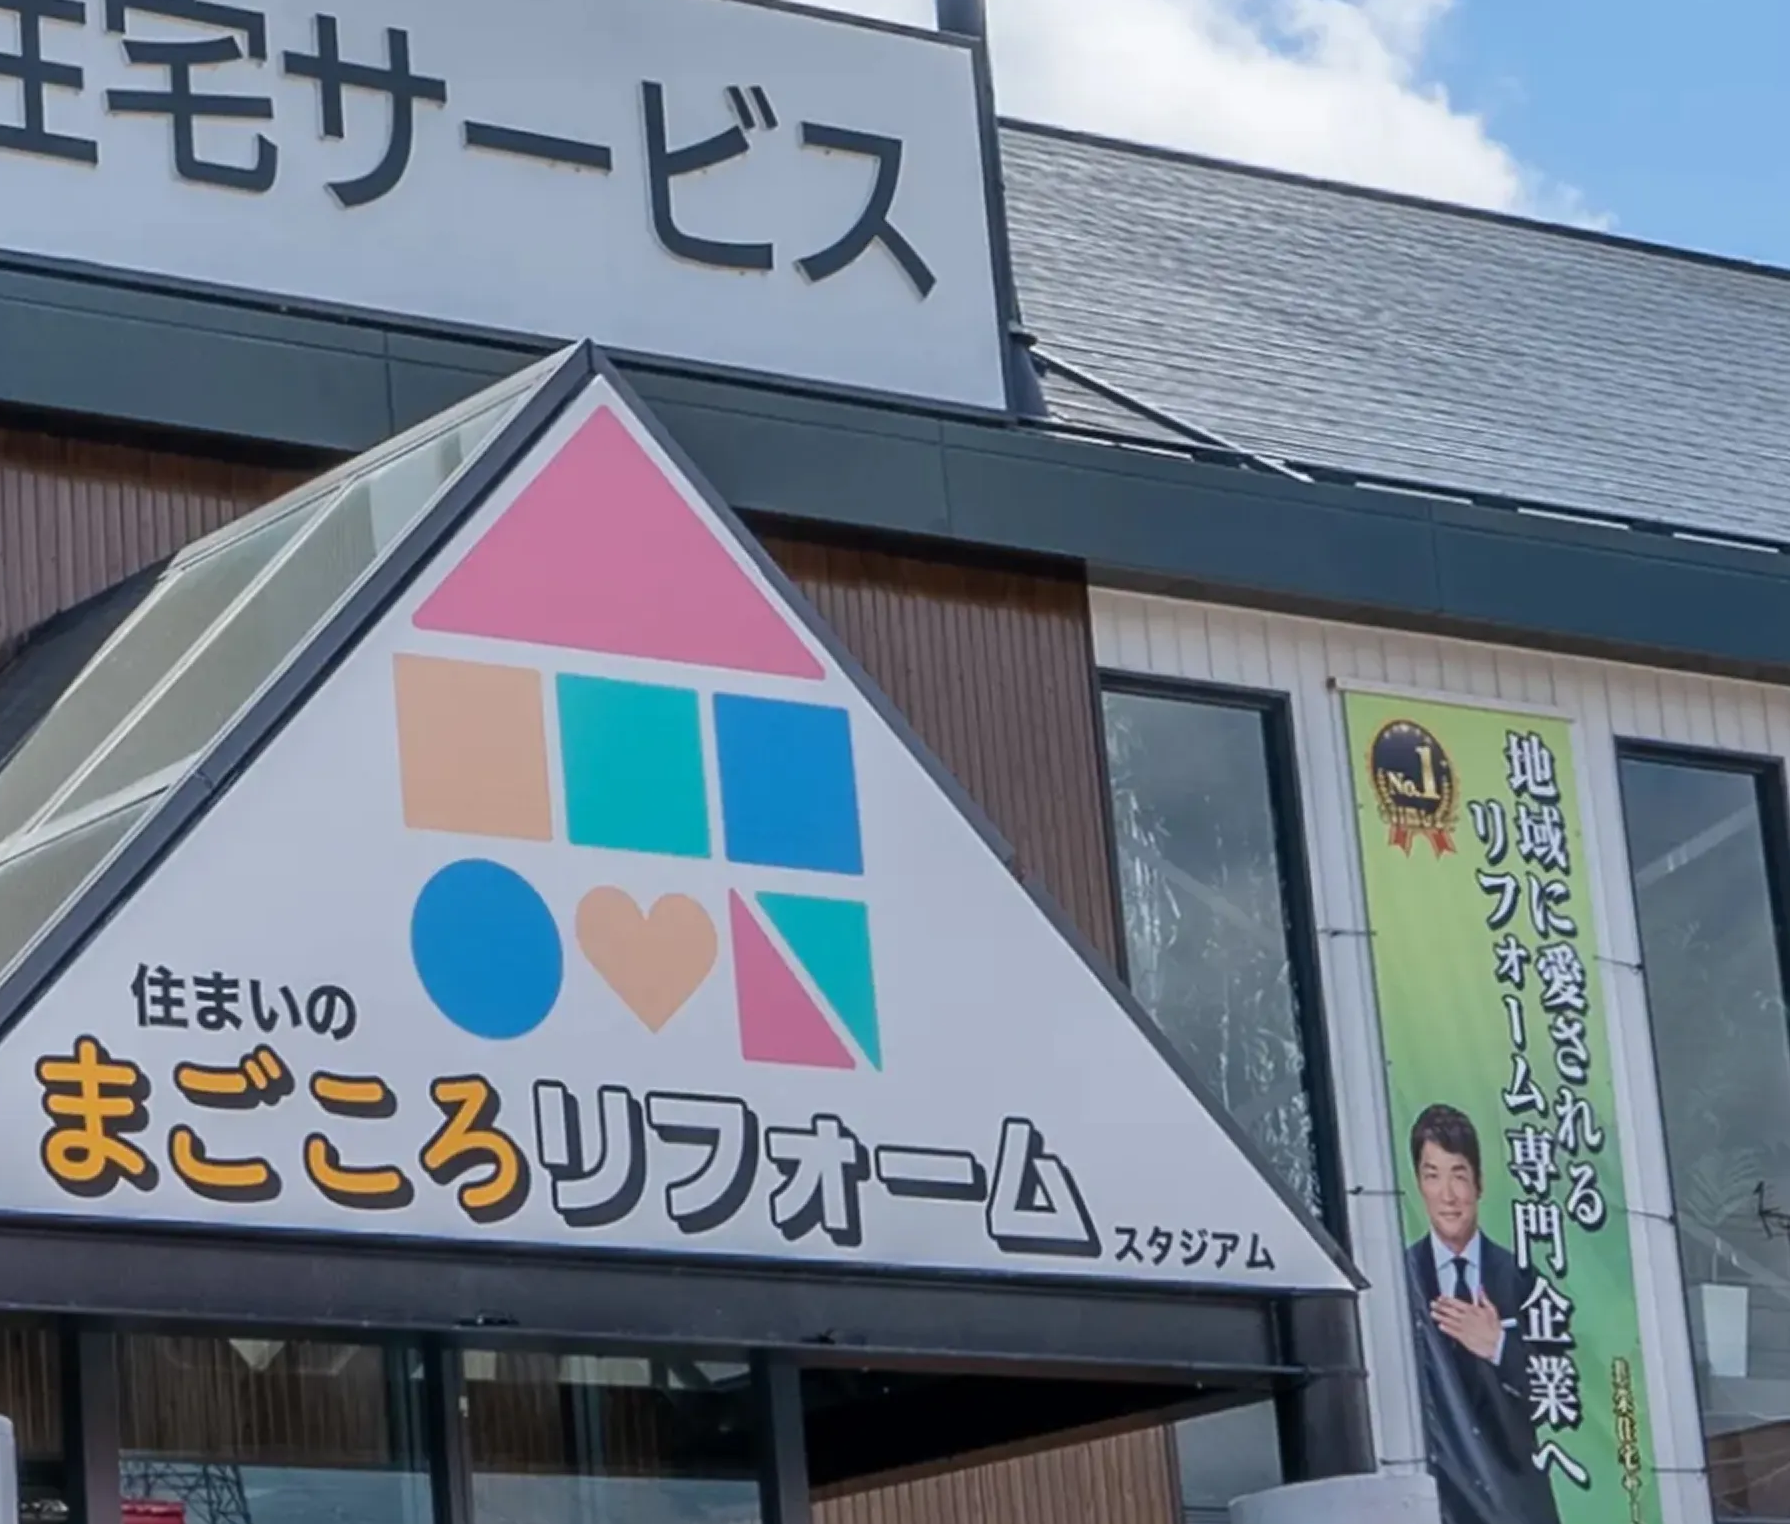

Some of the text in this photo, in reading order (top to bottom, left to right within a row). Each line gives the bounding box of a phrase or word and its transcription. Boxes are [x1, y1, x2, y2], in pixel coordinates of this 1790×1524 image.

[1387, 745, 1441, 801] No.1
[130, 962, 358, 1039] 住まいの
[1504, 731, 1606, 1230] 地域に愛される
[34, 1034, 1100, 1255] まごころリフォーム
[1471, 800, 1591, 1487] リフォーム専門企業へ
[1114, 1225, 1276, 1272] スタジアム
